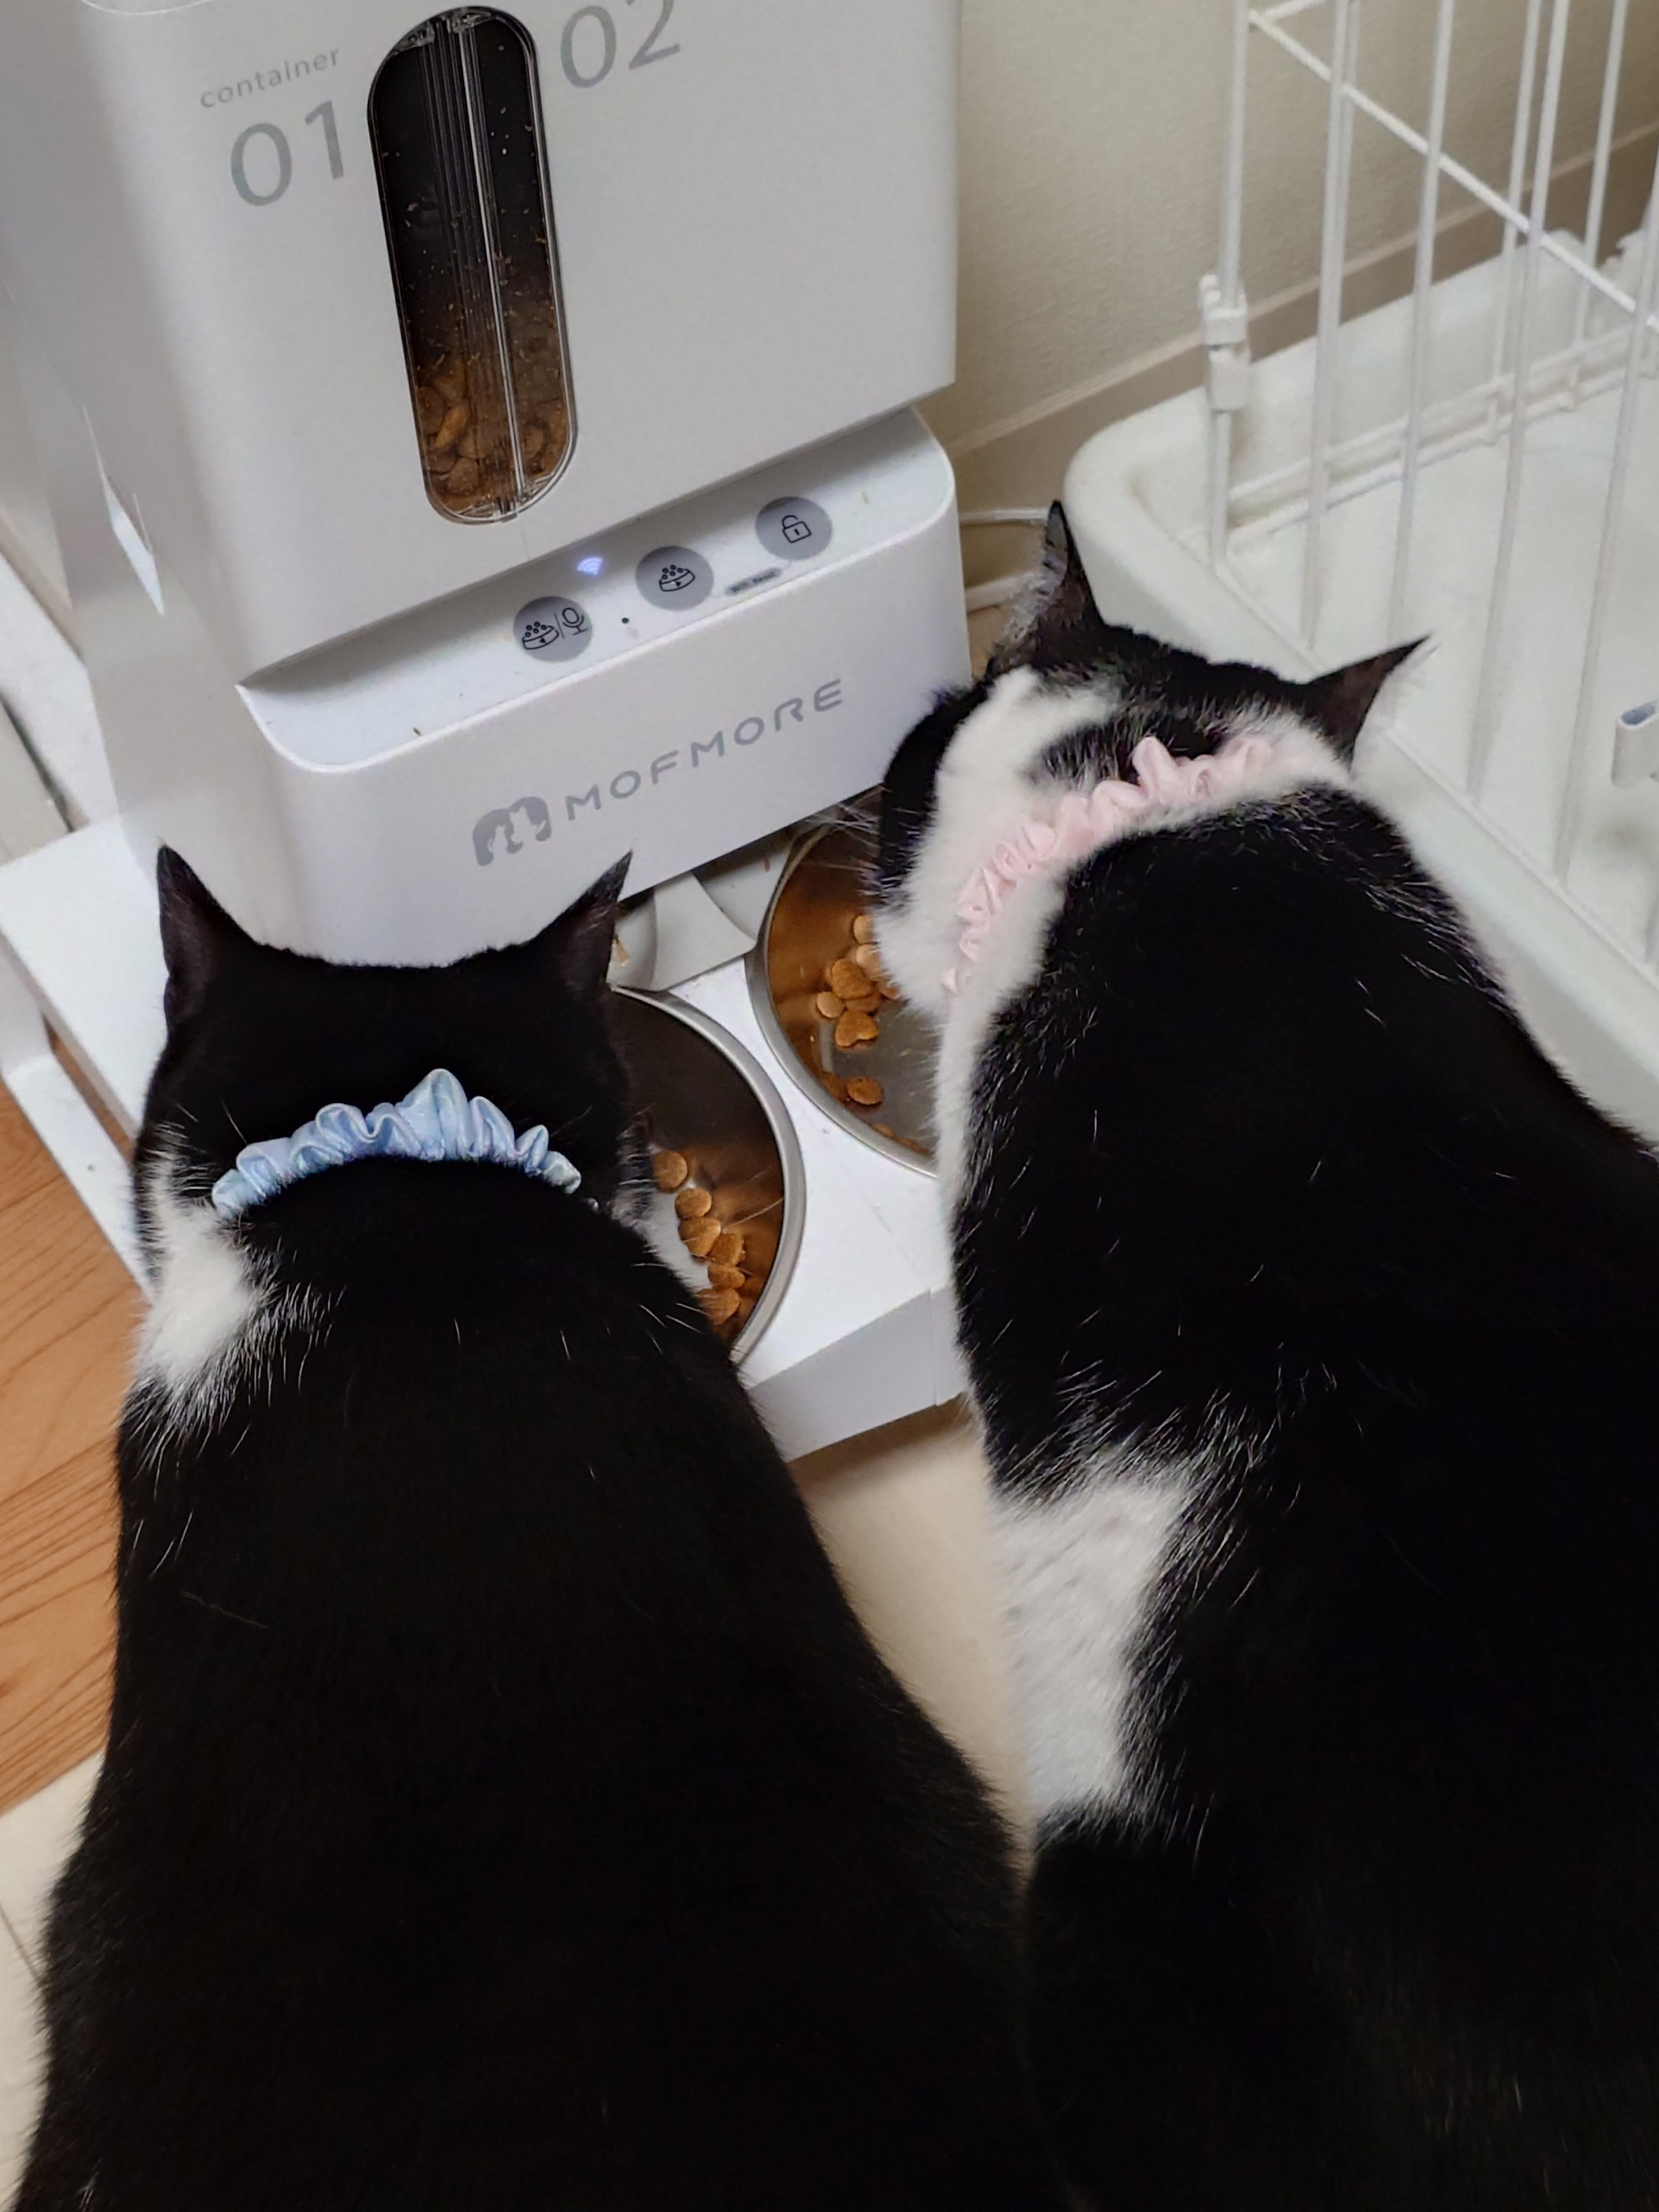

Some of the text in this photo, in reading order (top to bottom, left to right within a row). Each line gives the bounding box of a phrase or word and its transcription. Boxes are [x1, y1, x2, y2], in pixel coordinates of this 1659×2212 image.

[200, 49, 339, 108] container
[560, 0, 680, 88] 02
[230, 100, 344, 207] 01
[565, 679, 843, 821] MOFMORE
